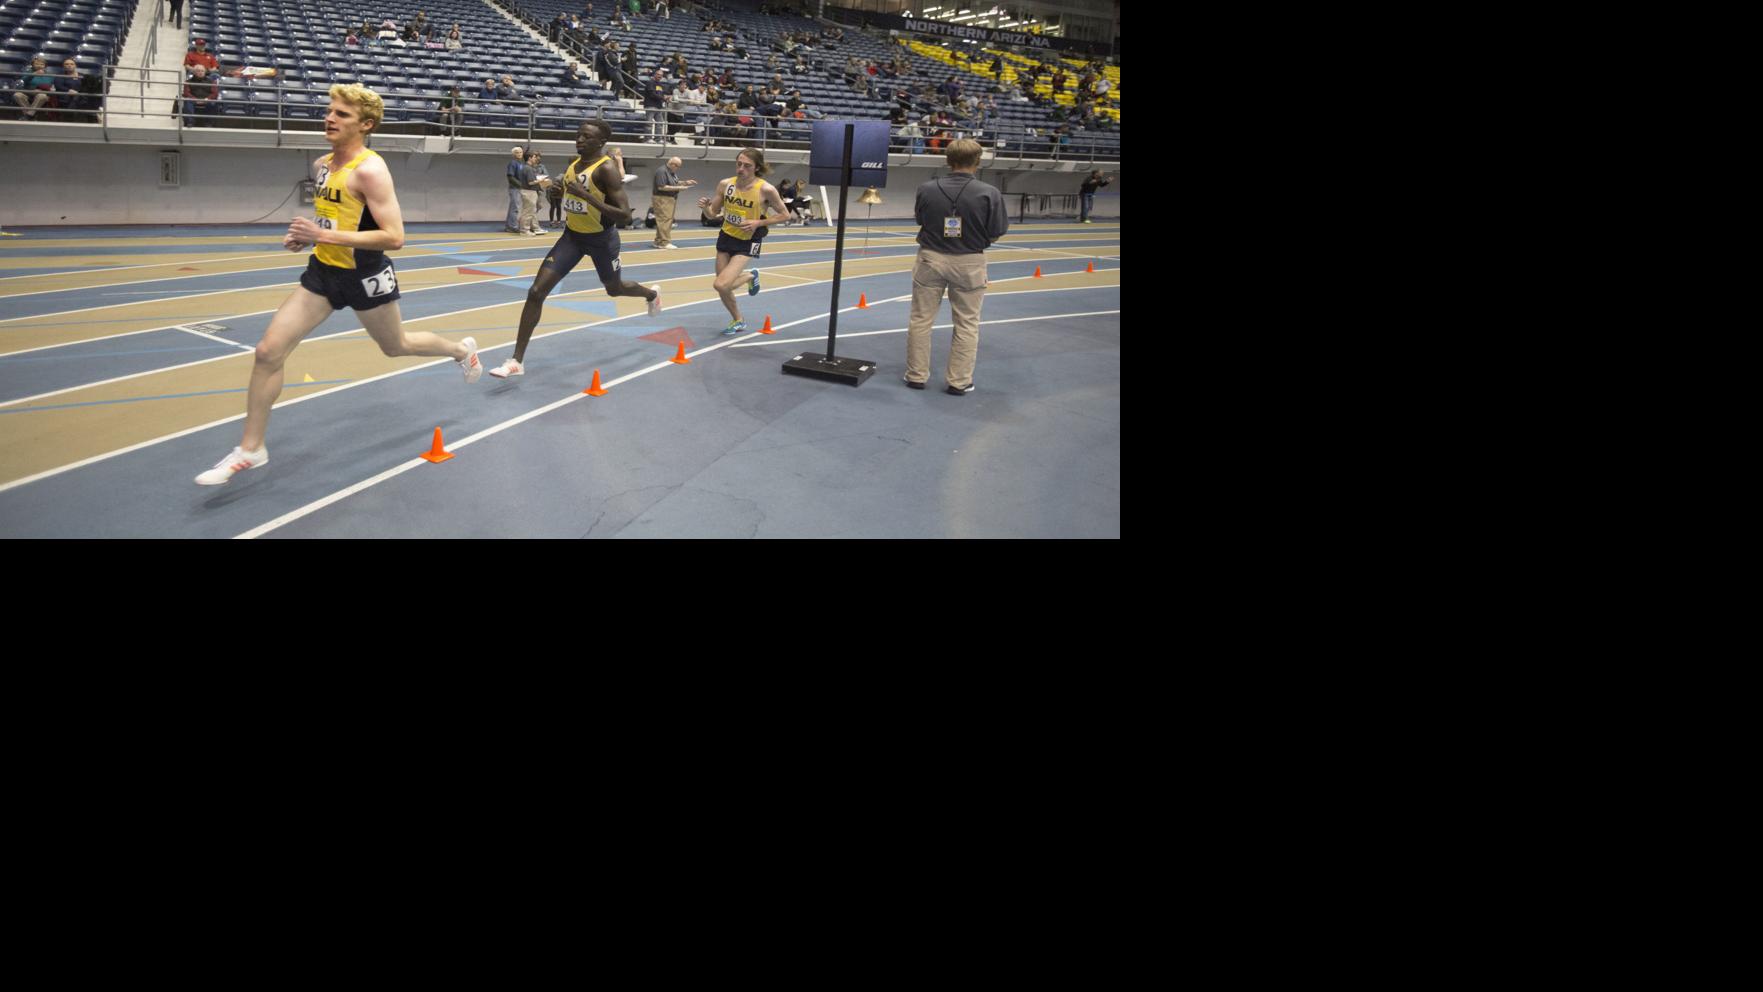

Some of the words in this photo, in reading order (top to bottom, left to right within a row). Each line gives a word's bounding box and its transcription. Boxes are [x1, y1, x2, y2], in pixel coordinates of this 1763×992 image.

[905, 20, 986, 39] NORTHERN
[727, 185, 734, 195] 6
[725, 195, 753, 208] NAU
[367, 270, 395, 296] 23
